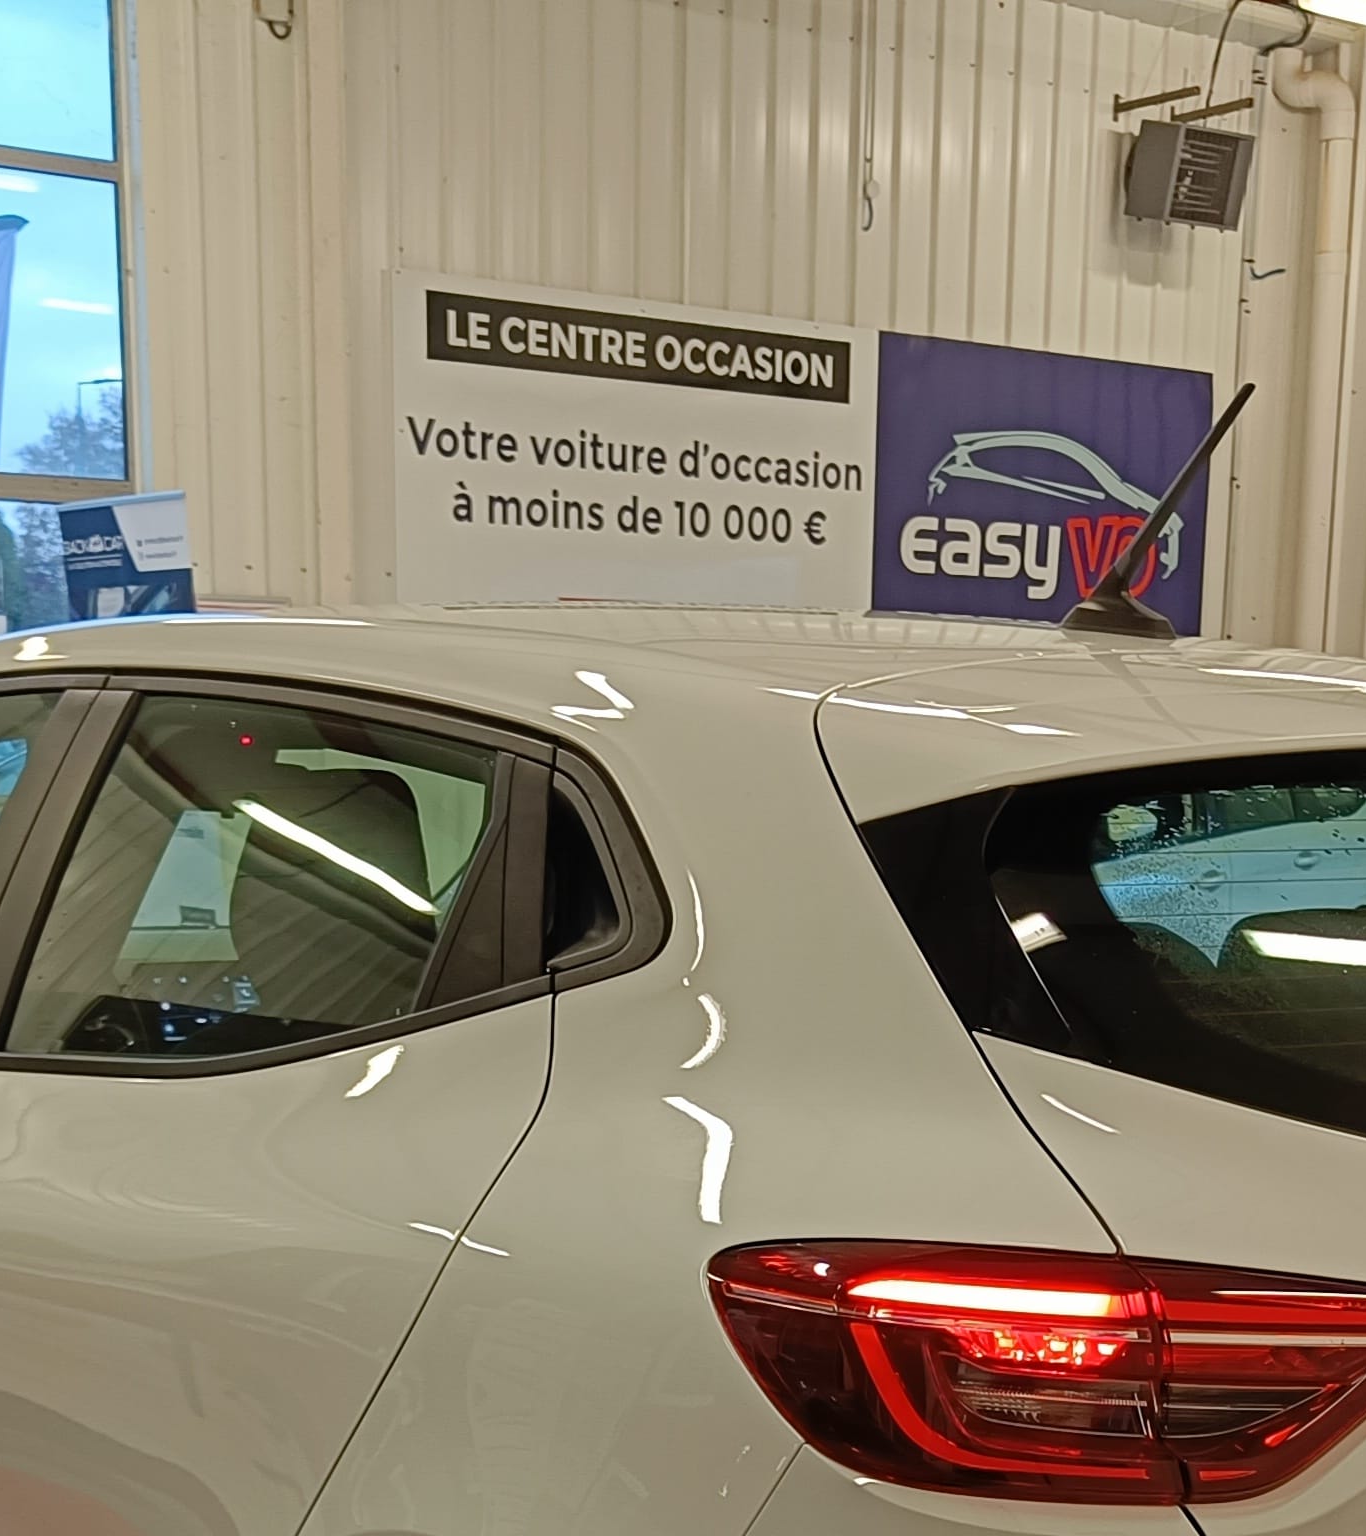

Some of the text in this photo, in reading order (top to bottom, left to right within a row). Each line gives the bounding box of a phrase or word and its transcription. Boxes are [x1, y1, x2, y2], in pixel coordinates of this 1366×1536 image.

[445, 309, 834, 388] LE CENTRE OCCASION
[406, 415, 863, 492] Votre voiture d'occasion
[452, 481, 828, 546] à moins de 10 000 €
